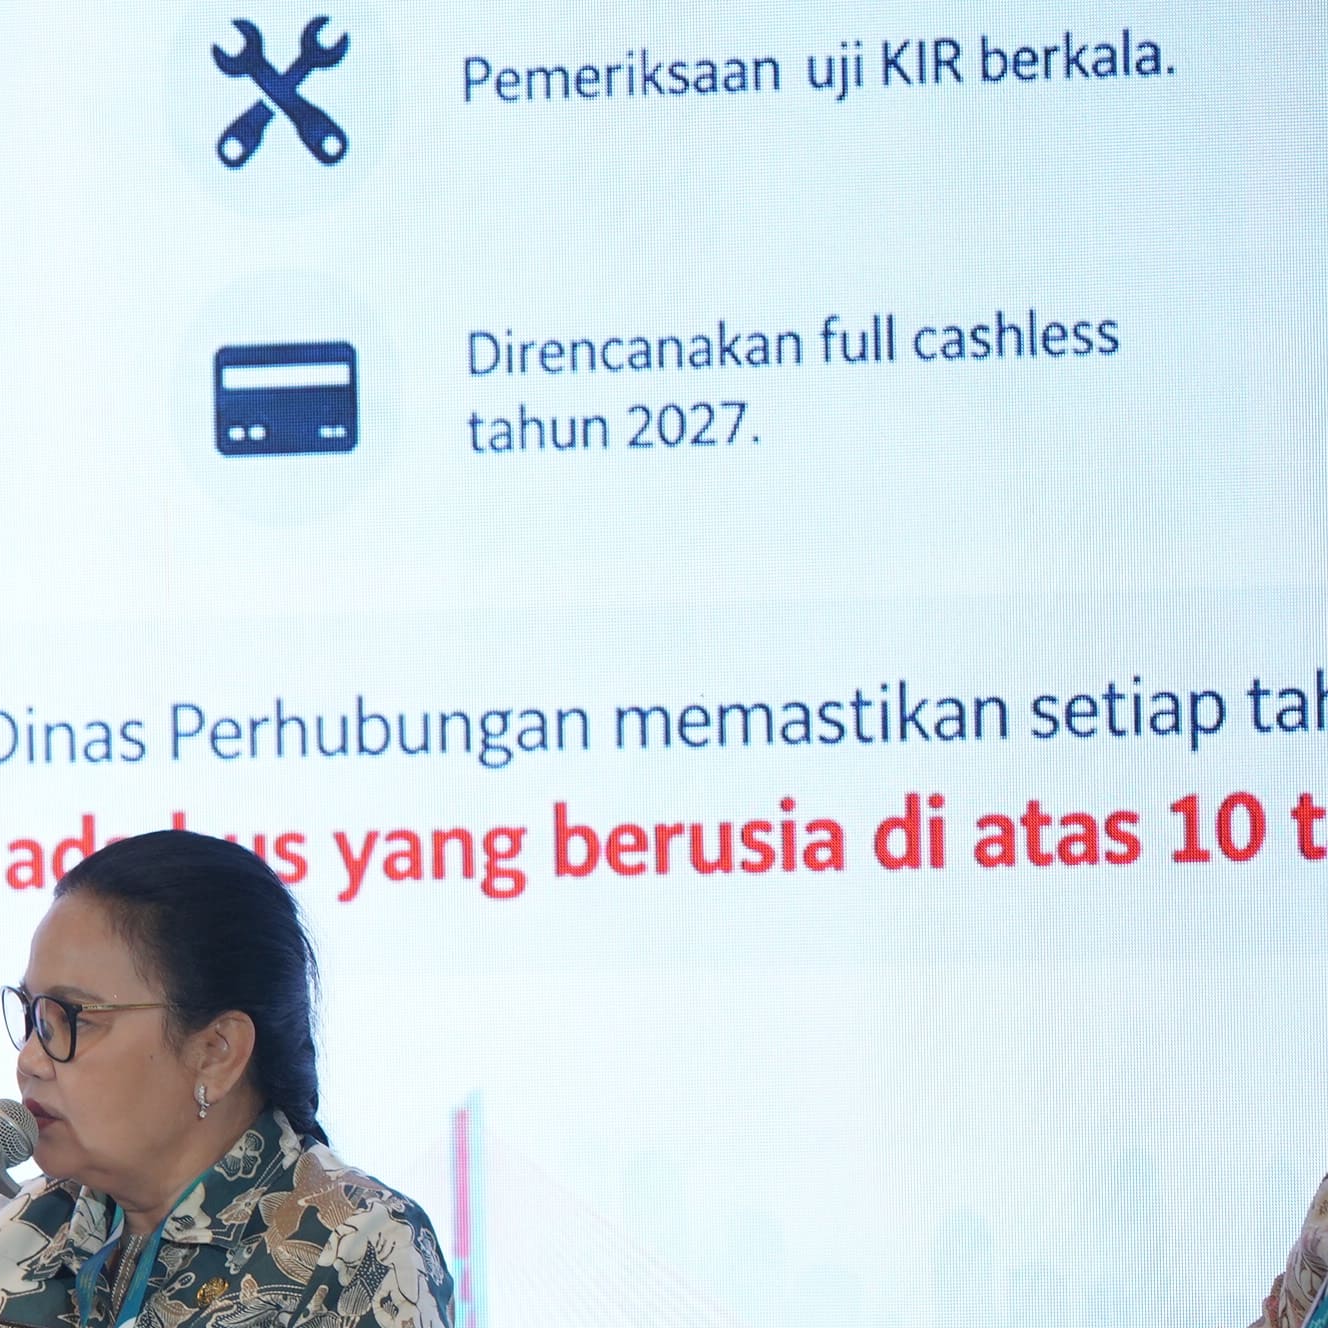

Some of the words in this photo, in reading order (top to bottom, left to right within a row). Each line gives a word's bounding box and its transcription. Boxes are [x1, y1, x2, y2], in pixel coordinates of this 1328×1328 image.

[463, 47, 781, 104] Pemeriksaan
[807, 39, 864, 104] uji
[881, 37, 964, 87] KIR
[980, 29, 1175, 85] berkala.
[468, 320, 804, 378] Direncanakan
[819, 313, 896, 365] full
[913, 308, 1120, 363] cashless
[468, 403, 610, 454] tahun
[628, 400, 761, 450] 2027.
[172, 695, 590, 770] Perhubungan
[615, 680, 1010, 750] memastikan
[1030, 675, 1227, 755] setiap
[5, 811, 128, 891] ad
[332, 826, 528, 903] yang
[553, 796, 845, 878] berusia
[873, 791, 946, 872] di
[973, 799, 1142, 869] atas
[1169, 790, 1267, 865] 10
